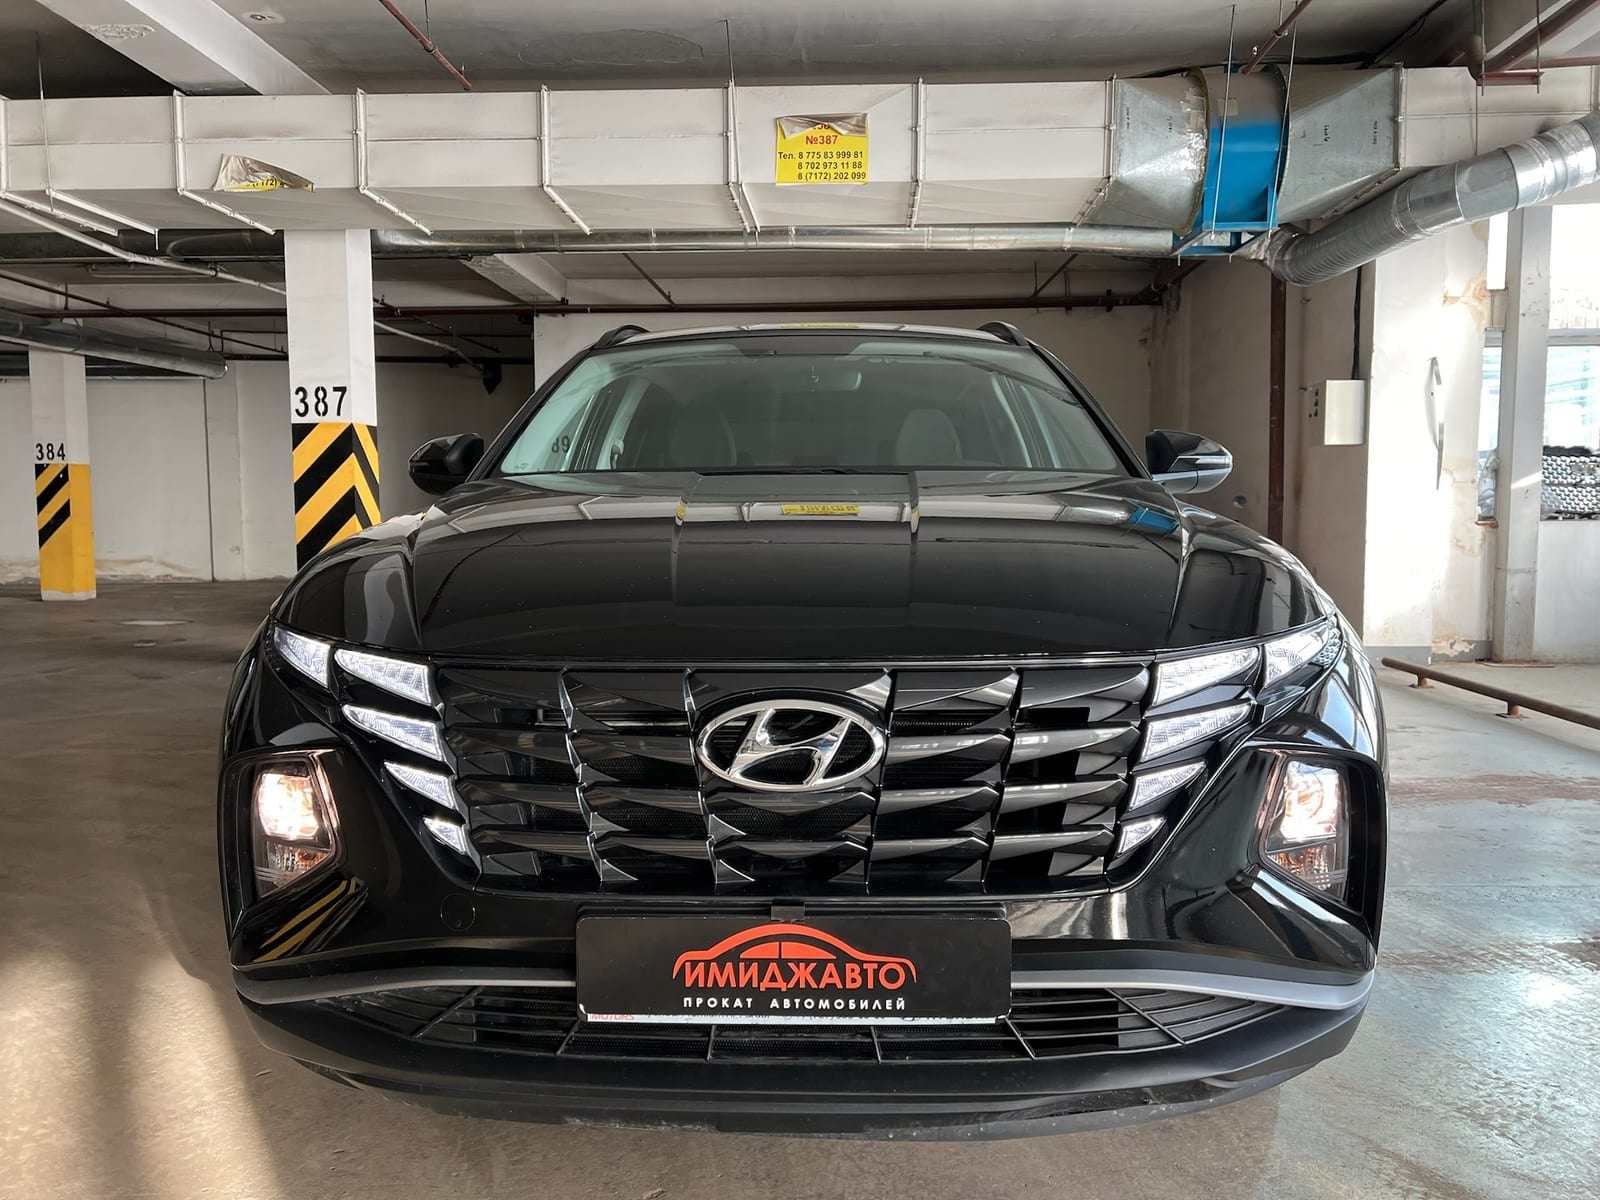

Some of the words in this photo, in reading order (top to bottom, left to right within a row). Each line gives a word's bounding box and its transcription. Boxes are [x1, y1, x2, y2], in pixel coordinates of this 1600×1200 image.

[805, 135, 838, 145] №387
[823, 151, 833, 159] 83
[836, 151, 851, 159] 999
[797, 162, 803, 170] 8
[805, 162, 820, 170] 702
[823, 162, 838, 170] 973
[841, 161, 850, 169] 11
[852, 161, 863, 169] 88
[797, 172, 803, 180] 8
[805, 172, 832, 181] (7172)
[834, 172, 849, 180] 202
[851, 172, 866, 180] 099
[294, 386, 348, 418] 387
[35, 442, 66, 461] 384
[685, 961, 906, 992] ИМИДЖАВТО
[683, 997, 753, 1008] ПРОКАТ
[769, 998, 906, 1010] АВТОМОБИЛЕЙ
